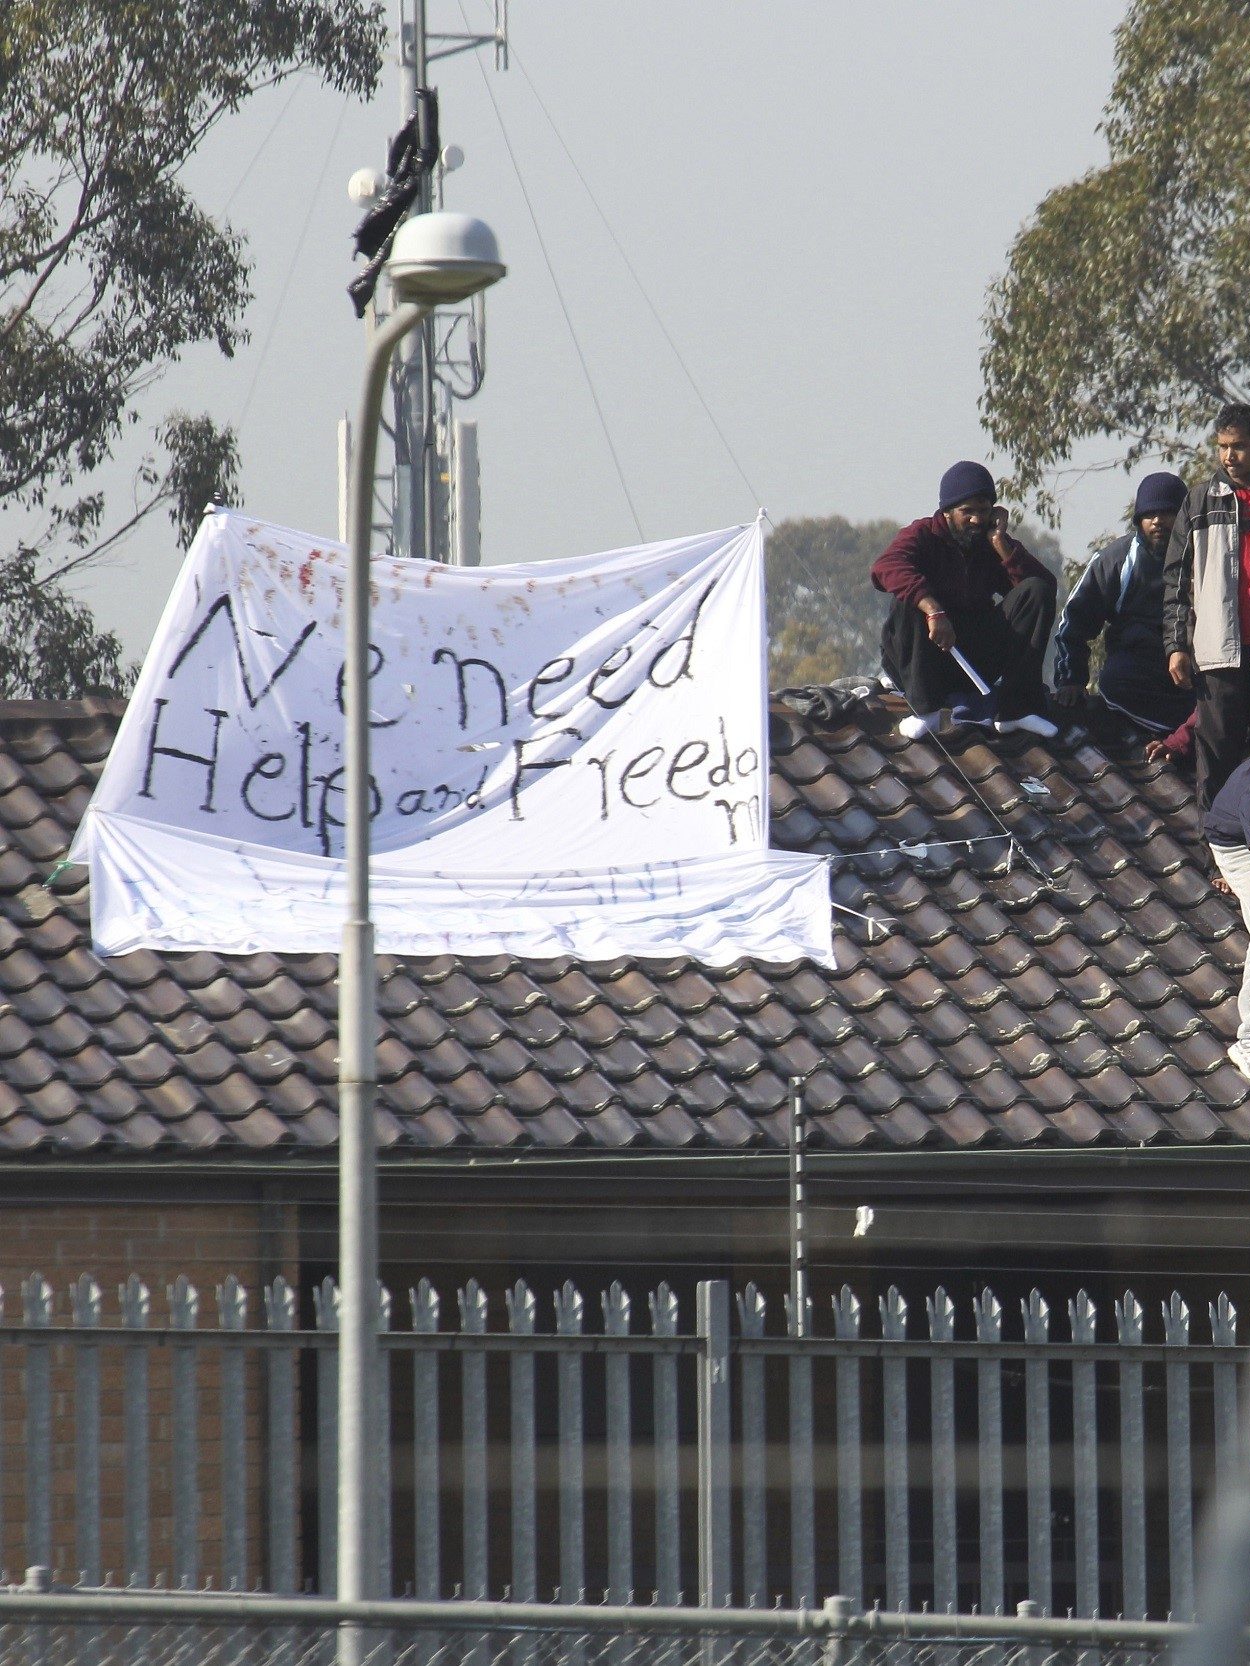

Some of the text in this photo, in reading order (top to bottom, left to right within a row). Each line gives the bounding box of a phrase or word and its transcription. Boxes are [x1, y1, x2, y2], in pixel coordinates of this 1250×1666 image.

[431, 578, 717, 730] need
[137, 697, 382, 857] Help
[396, 764, 487, 816] and
